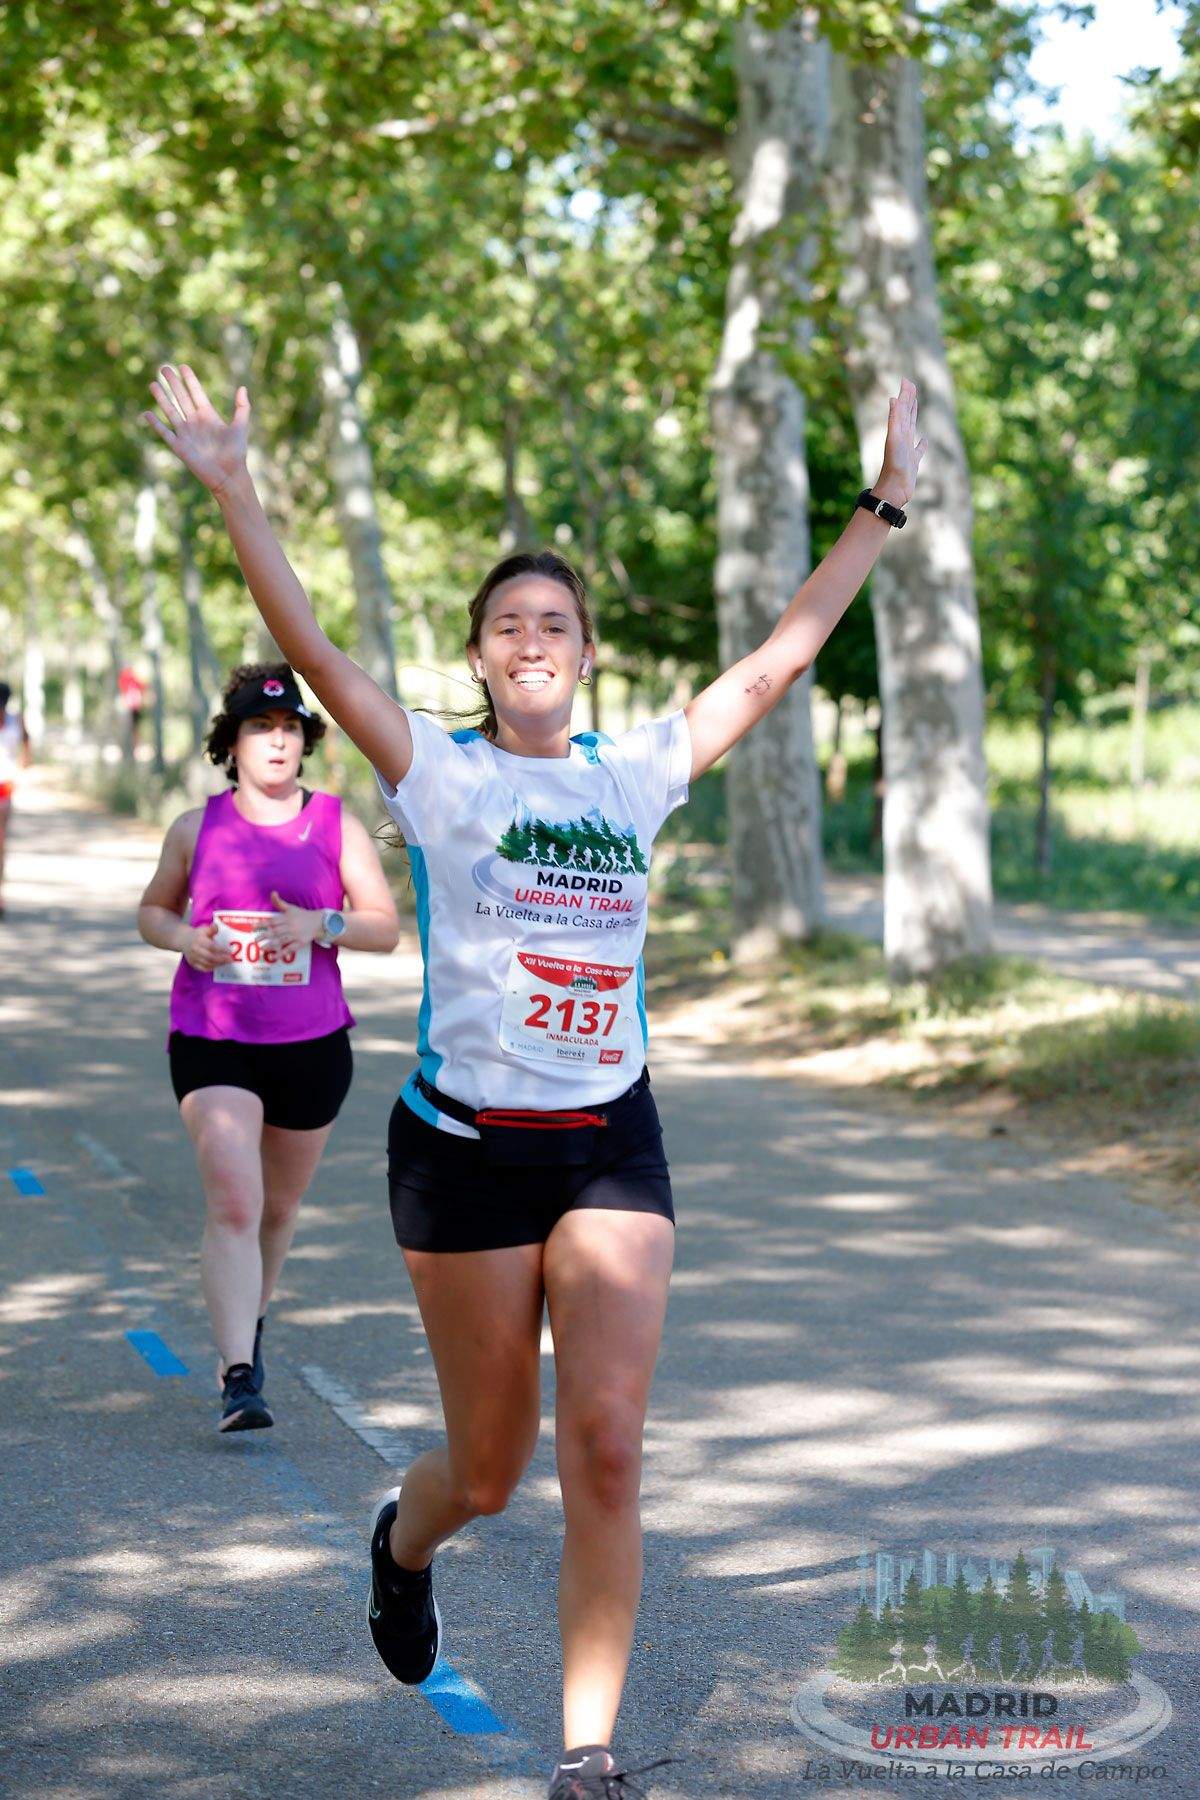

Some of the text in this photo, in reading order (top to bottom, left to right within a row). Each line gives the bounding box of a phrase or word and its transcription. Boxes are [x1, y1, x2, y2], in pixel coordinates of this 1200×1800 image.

[536, 871, 623, 894] MADRID
[514, 888, 634, 913] URBAN TRAIL
[475, 902, 491, 916] La
[495, 905, 540, 923] Vuelta
[544, 914, 552, 924] a
[556, 913, 568, 925] la
[572, 915, 602, 929] Casa
[605, 917, 620, 929] de
[537, 958, 565, 971] Vuelta
[573, 963, 583, 973] la
[585, 966, 603, 975] Casa
[524, 994, 619, 1036] 2137
[546, 1033, 599, 1046] INMACULADA
